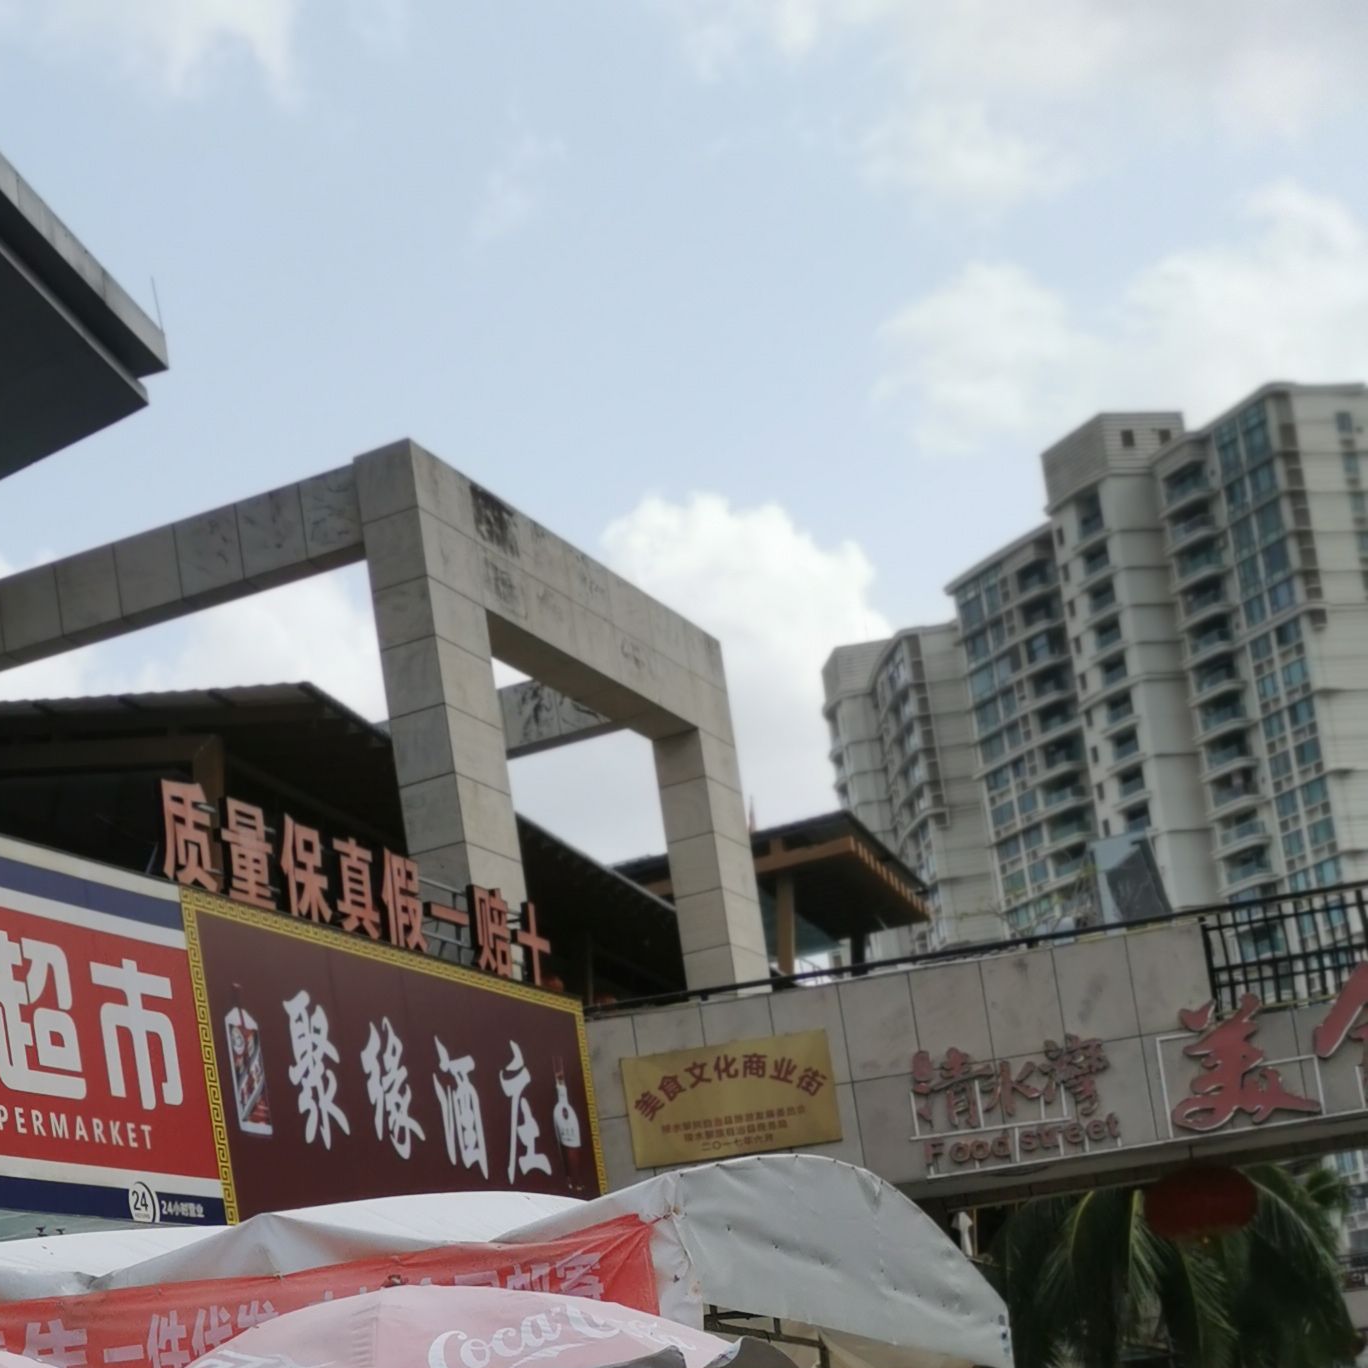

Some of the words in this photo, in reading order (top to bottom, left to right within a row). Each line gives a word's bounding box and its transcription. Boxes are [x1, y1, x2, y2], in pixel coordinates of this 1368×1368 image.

[161, 778, 552, 986] 质量保真假一赔十
[283, 990, 553, 1185] 聚缘酒庄
[634, 1053, 828, 1122] 美食文化商业街
[912, 1033, 1110, 1128] 清水湾
[924, 1132, 1012, 1166] Food
[1020, 1112, 1122, 1152] street
[131, 1190, 149, 1211] 24
